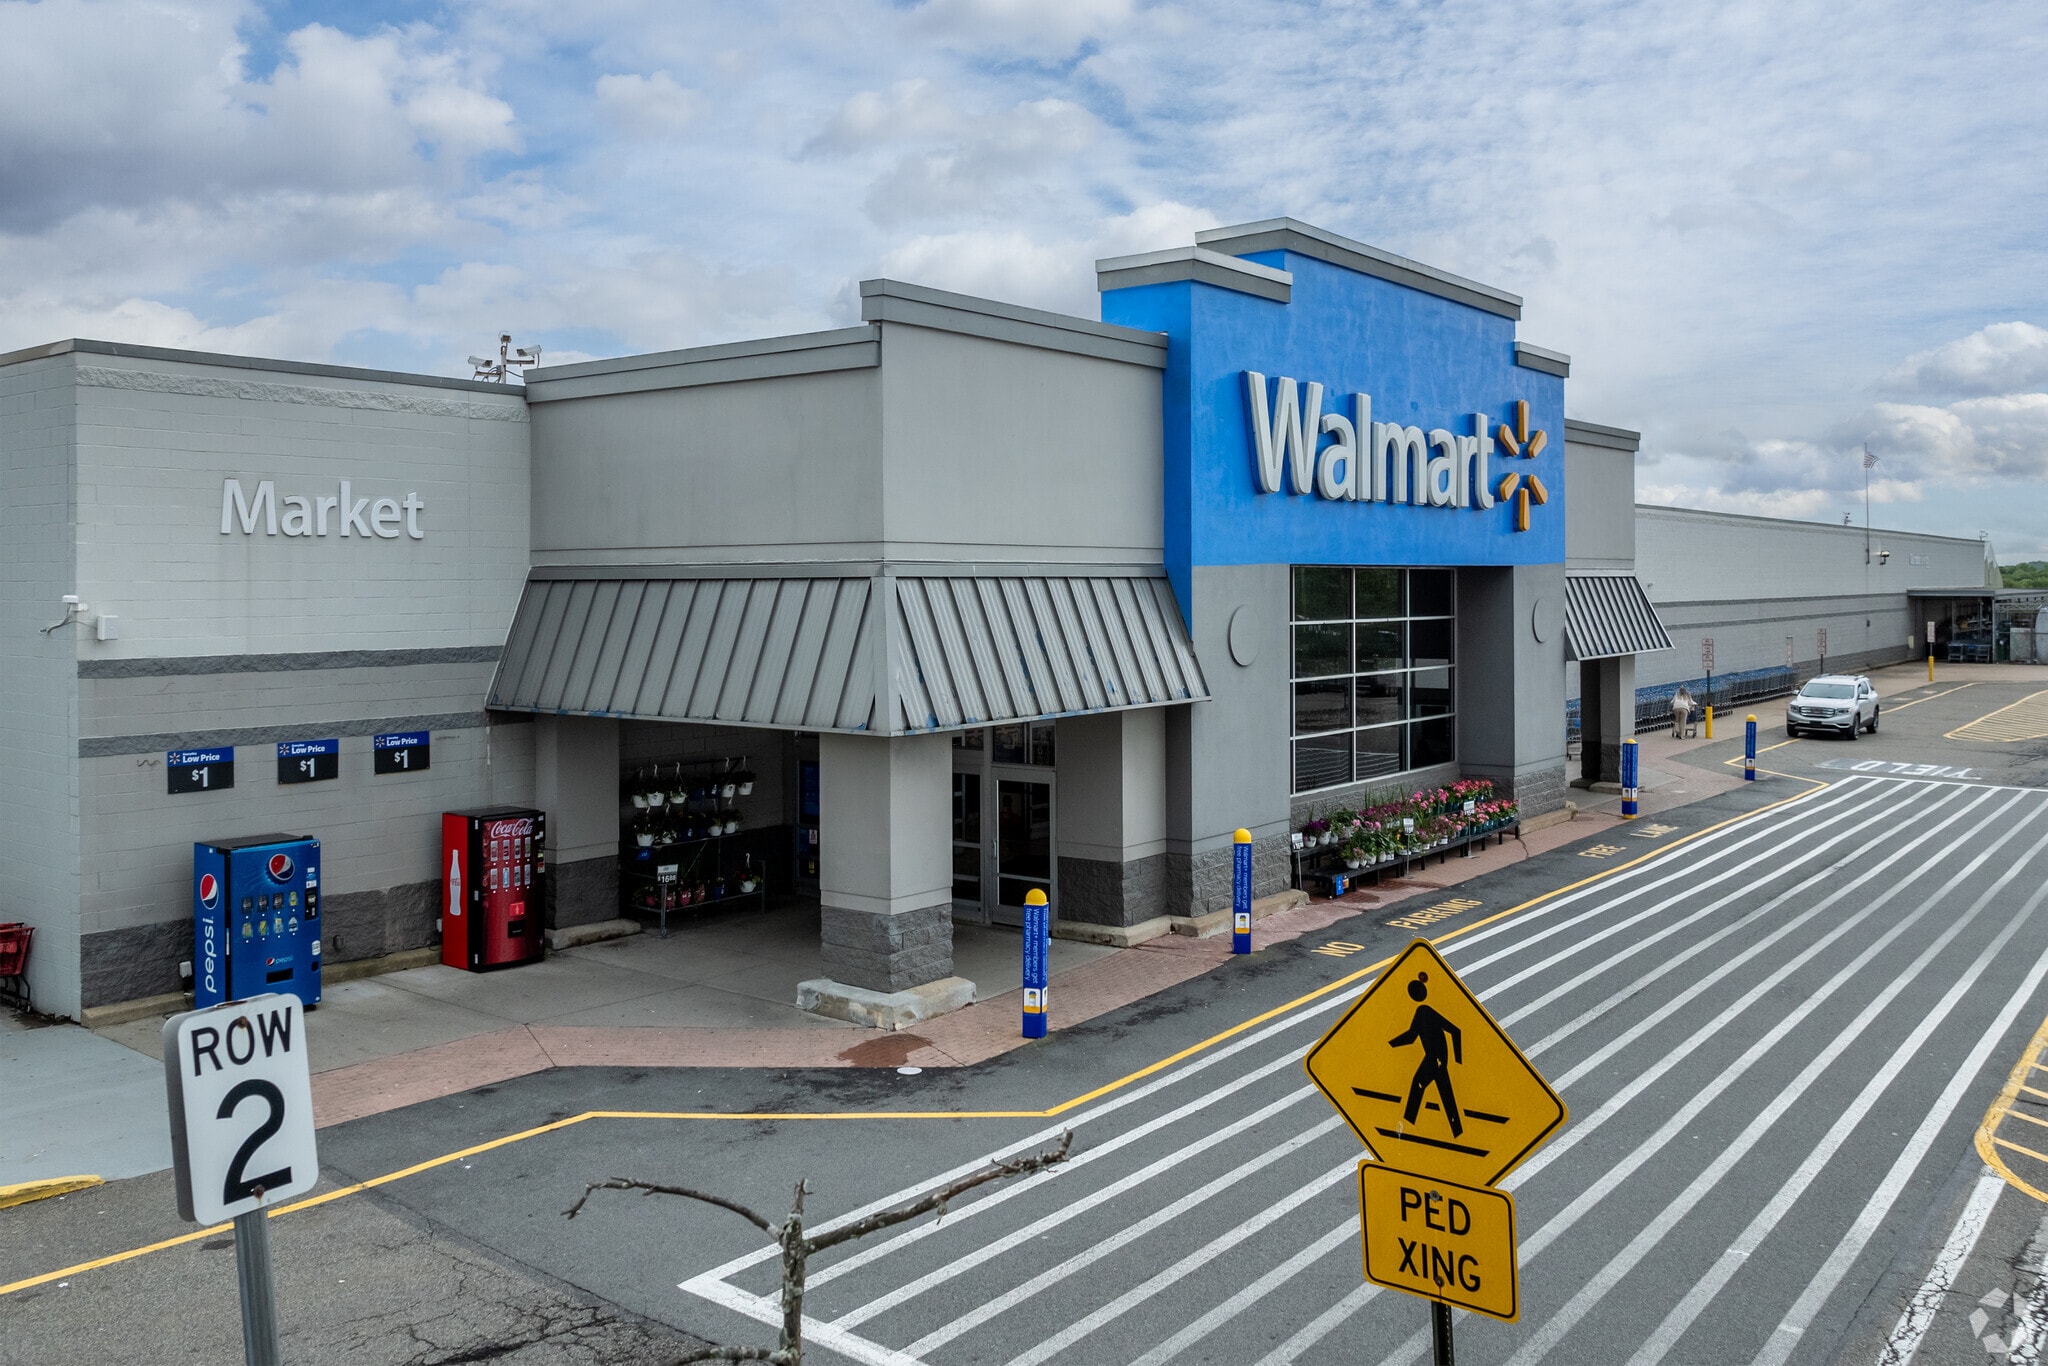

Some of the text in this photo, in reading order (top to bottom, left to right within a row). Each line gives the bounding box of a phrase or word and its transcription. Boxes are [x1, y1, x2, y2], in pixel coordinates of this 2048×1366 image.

[1242, 369, 1494, 511] Walmart
[220, 478, 424, 539] Market
[182, 755, 200, 763] Low
[200, 753, 220, 762] Price
[291, 746, 307, 754] Low
[308, 745, 326, 753] Price
[300, 757, 315, 777] $1
[386, 739, 401, 747] Low
[401, 737, 418, 745] Price
[394, 749, 409, 768] $1
[192, 766, 208, 787] $1
[1850, 760, 1982, 780] YIELD
[1311, 941, 1366, 958] NO
[1386, 898, 1483, 930] PARKING
[202, 915, 217, 994] pepsi
[191, 1006, 292, 1077] ROW
[216, 1078, 293, 1206] 2
[1400, 1186, 1471, 1236] PED
[1397, 1236, 1481, 1293] XING
